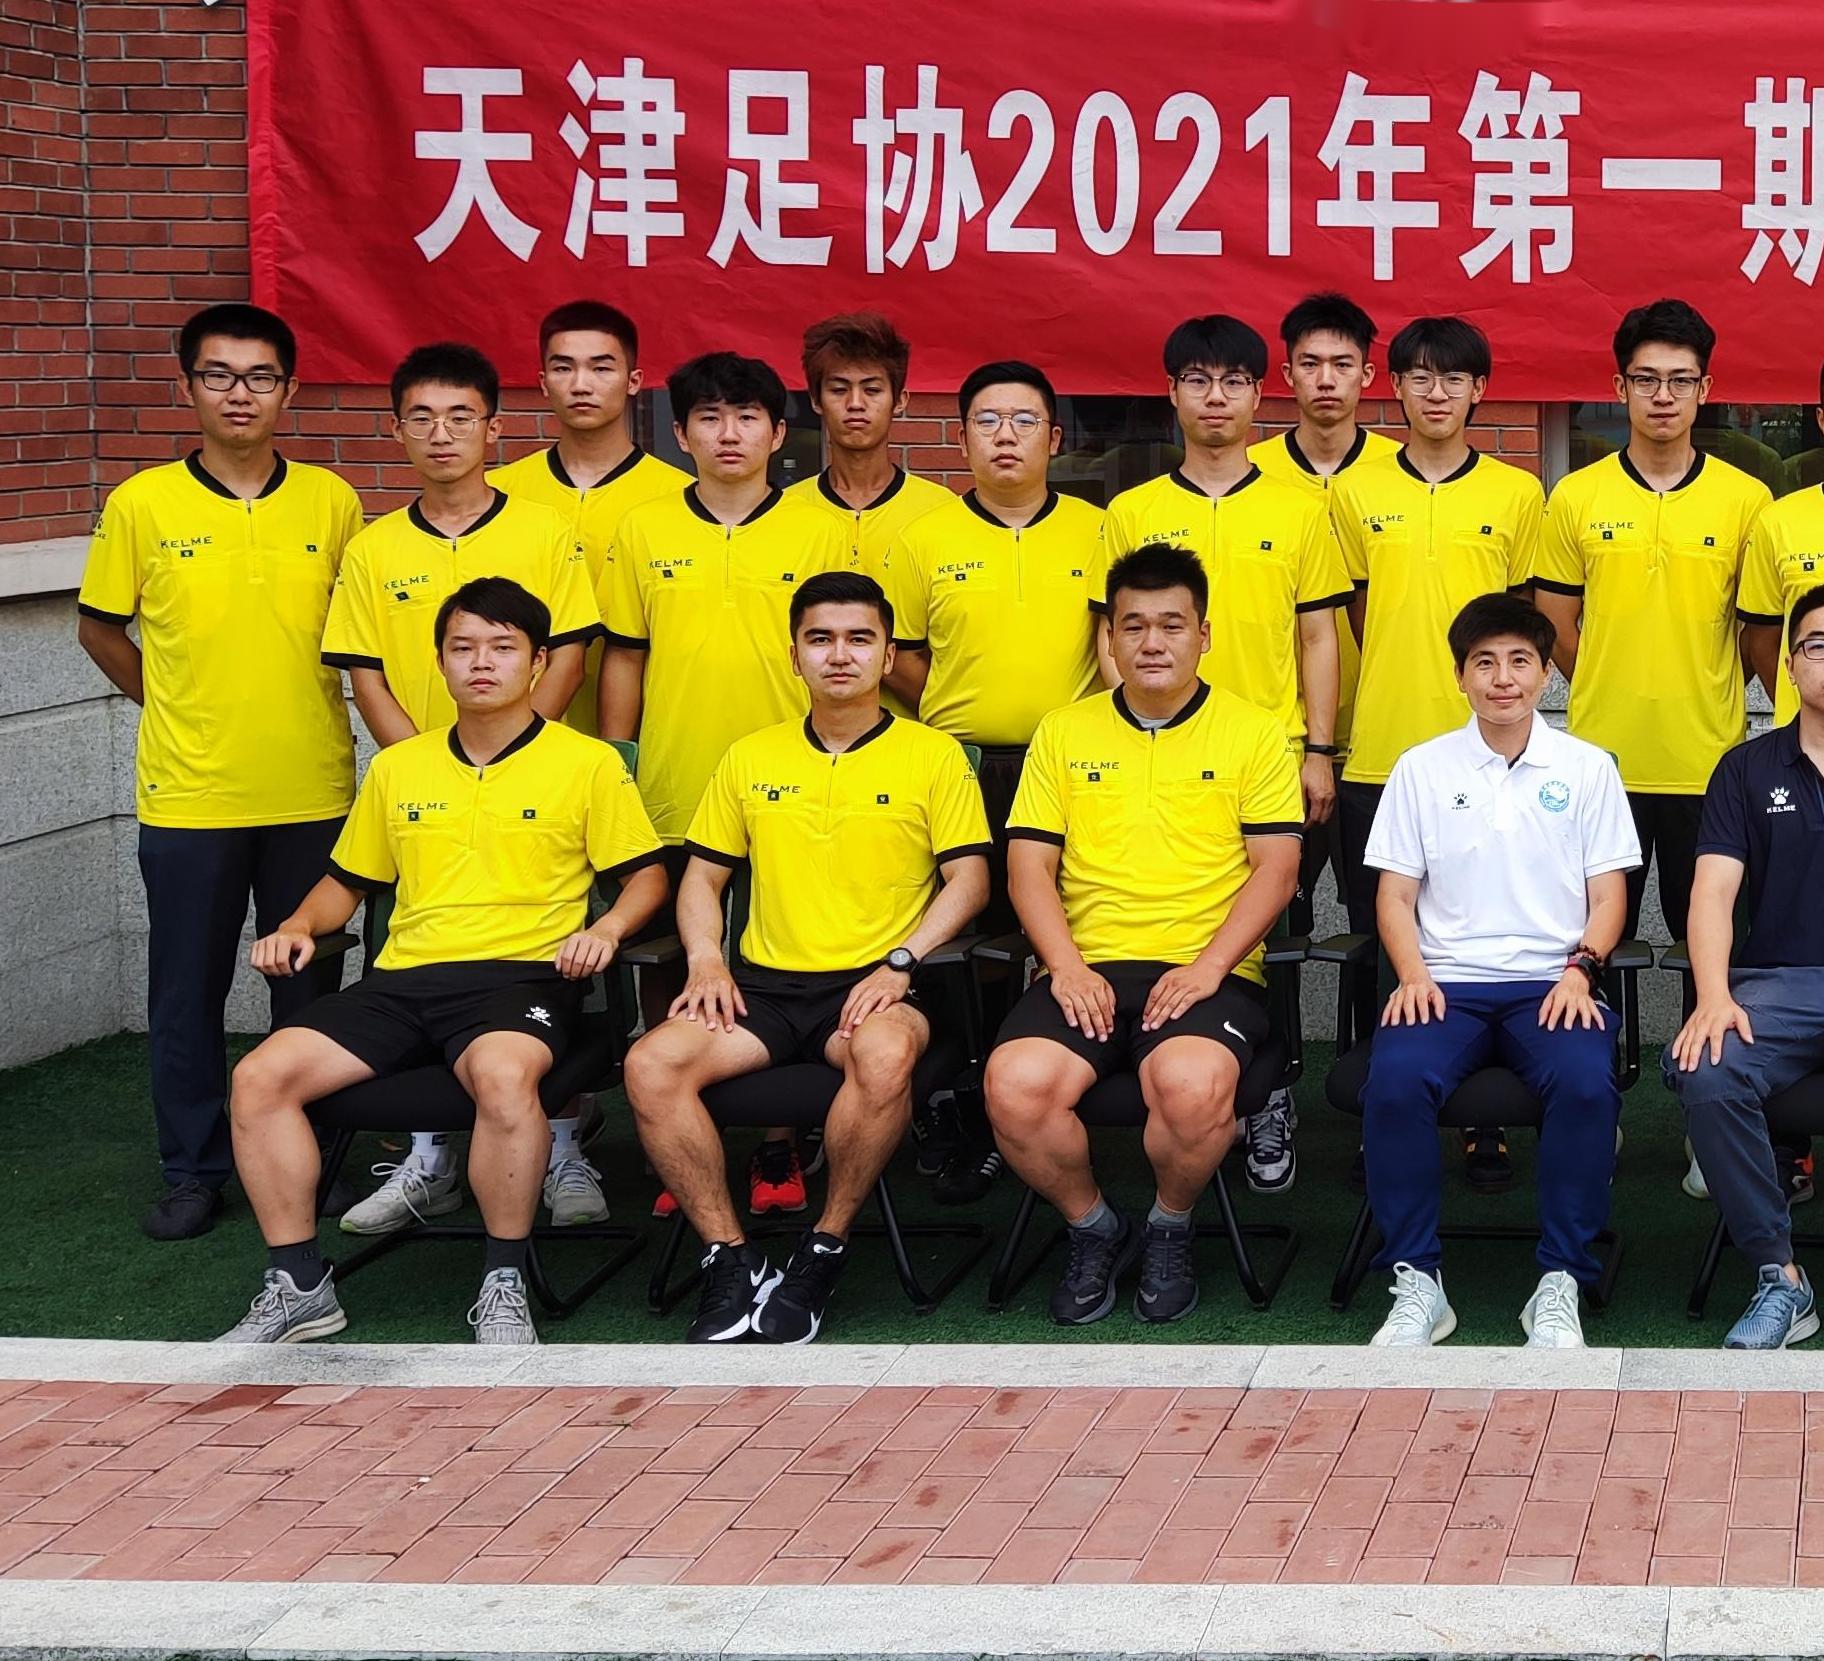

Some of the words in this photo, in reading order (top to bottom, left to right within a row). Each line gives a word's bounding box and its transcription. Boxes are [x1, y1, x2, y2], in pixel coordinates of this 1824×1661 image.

[1363, 515, 1404, 525] KELME
[1589, 521, 1634, 530] KELME
[1143, 529, 1190, 544] KELME
[160, 536, 212, 549] KELME
[648, 559, 692, 569] KELME
[938, 562, 984, 574] KELME
[384, 575, 429, 590] KELME
[1070, 761, 1119, 770] KELME
[751, 783, 801, 794] KELME
[397, 803, 448, 811] KELME
[1766, 804, 1796, 813] KELME
